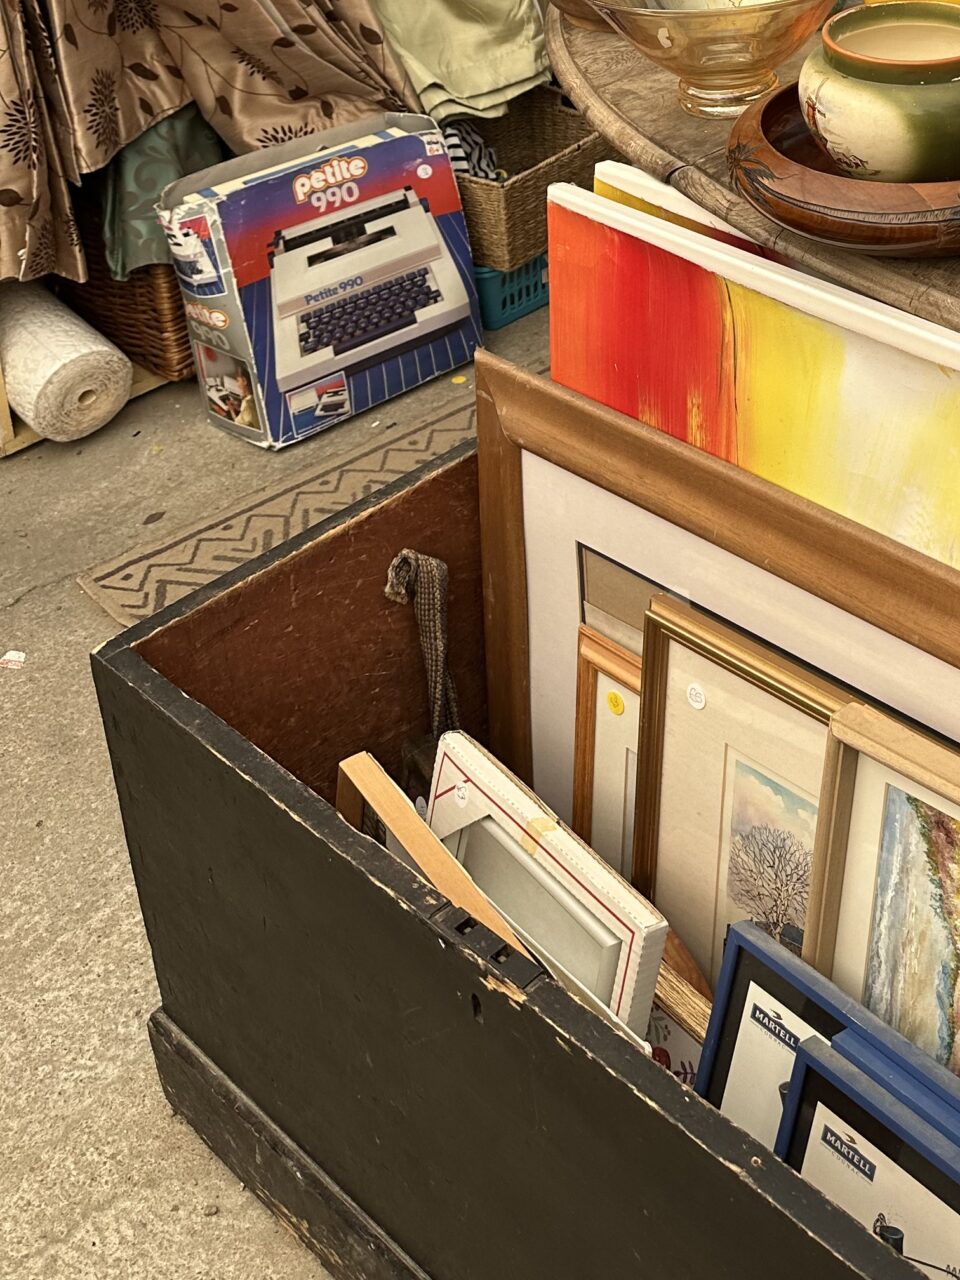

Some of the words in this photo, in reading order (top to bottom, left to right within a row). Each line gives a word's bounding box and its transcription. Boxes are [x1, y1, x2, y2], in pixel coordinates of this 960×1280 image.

[293, 157, 367, 204] petite
[311, 182, 360, 212] 990
[304, 287, 338, 305] Petite
[339, 276, 363, 292] 990
[755, 1009, 797, 1048] MARTELL
[826, 1131, 871, 1175] MARTELL
